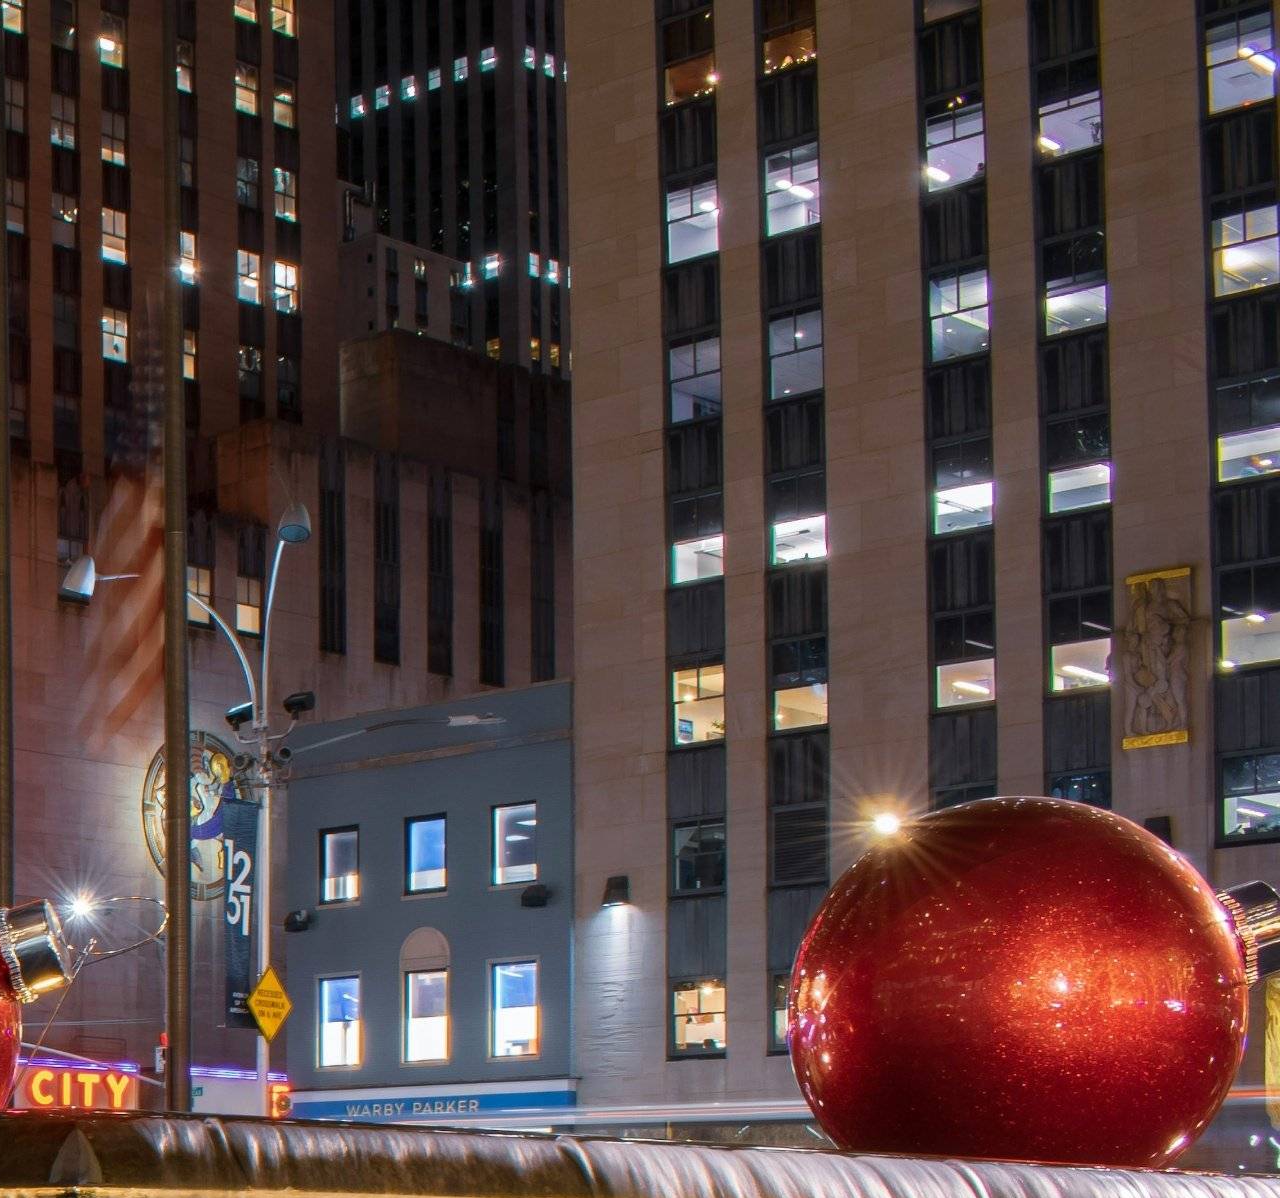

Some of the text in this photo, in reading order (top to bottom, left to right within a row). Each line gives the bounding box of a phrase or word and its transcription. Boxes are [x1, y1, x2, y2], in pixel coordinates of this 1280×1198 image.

[31, 1070, 130, 1108] CITY
[346, 1100, 480, 1117] WARBY PARKER
